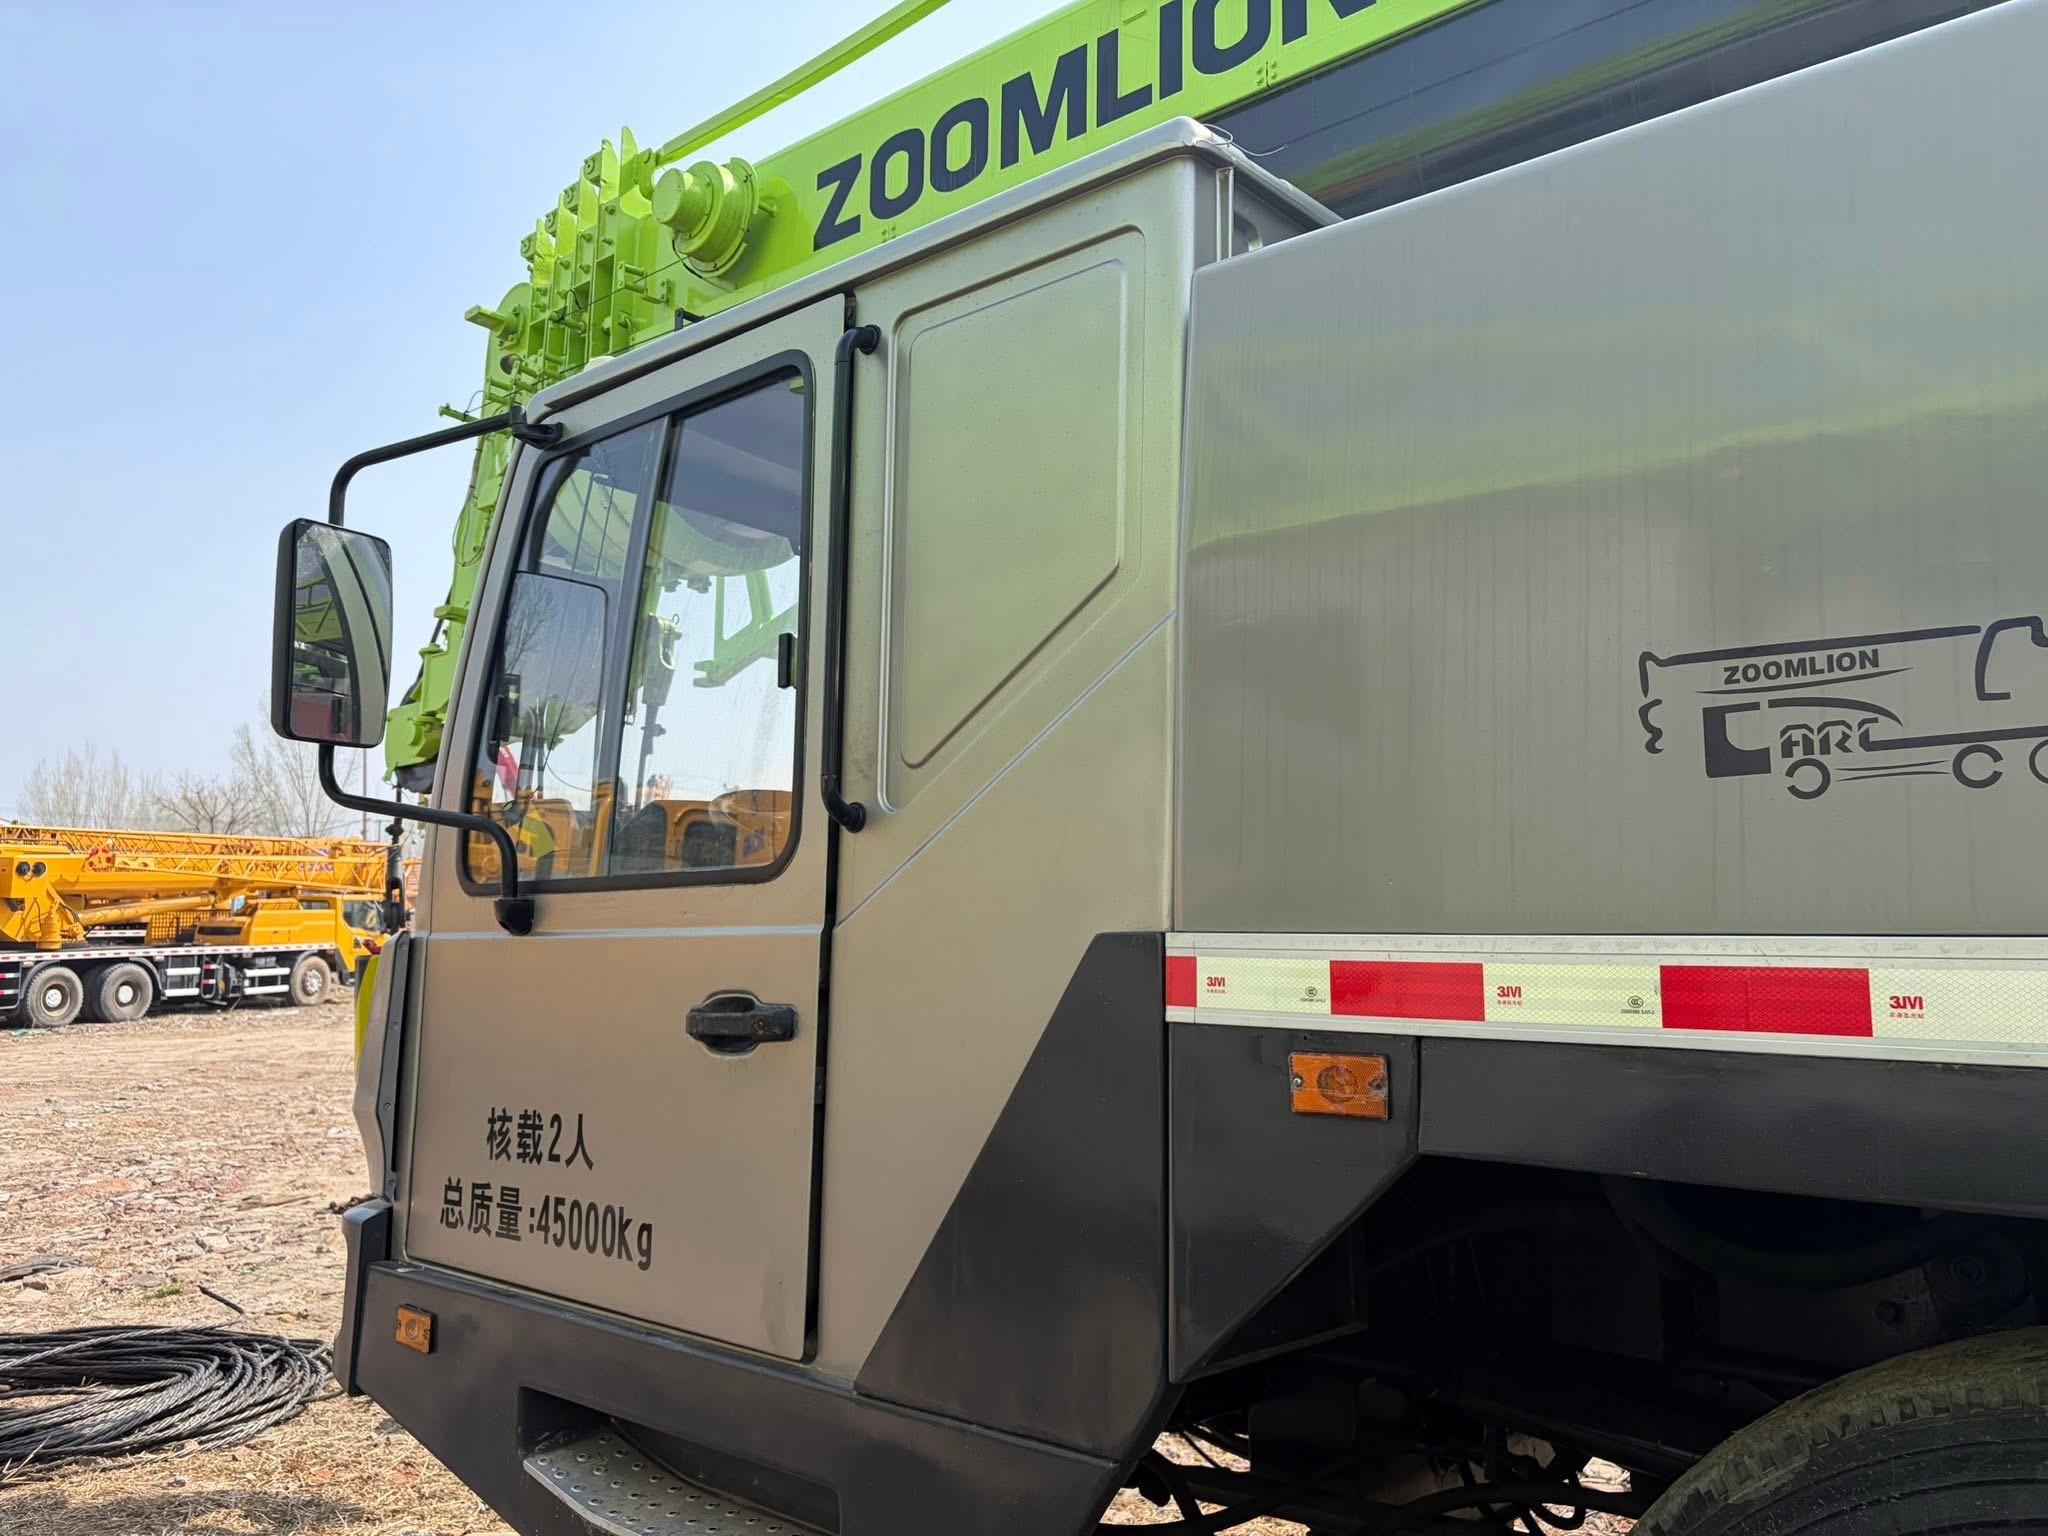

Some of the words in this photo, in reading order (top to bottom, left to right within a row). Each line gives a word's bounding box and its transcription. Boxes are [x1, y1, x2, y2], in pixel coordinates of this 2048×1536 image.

[1723, 648, 1880, 686] ZOOMLION
[1206, 976, 1226, 987] 3M
[1497, 985, 1522, 998] 3M
[1889, 995, 1924, 1010] 3M
[486, 1107, 594, 1171] 核载2人
